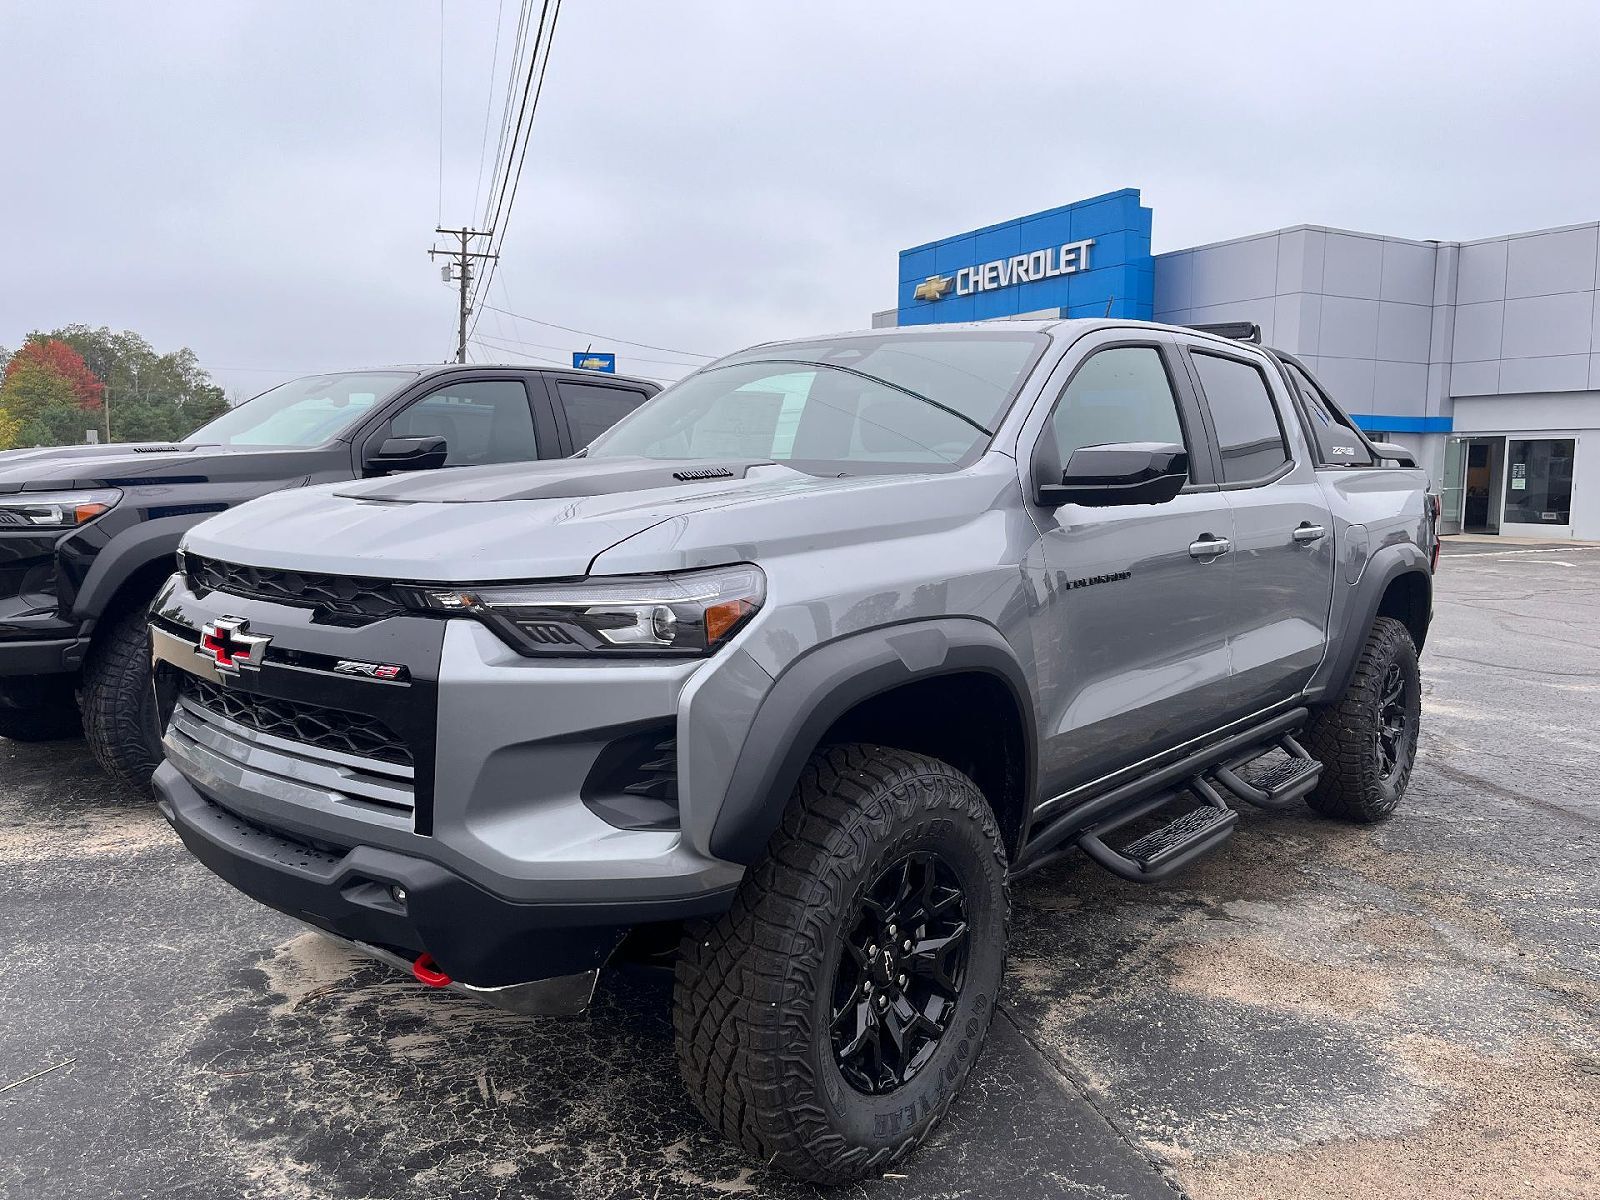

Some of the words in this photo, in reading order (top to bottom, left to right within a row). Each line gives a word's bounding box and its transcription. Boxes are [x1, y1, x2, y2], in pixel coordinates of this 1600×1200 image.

[956, 238, 1096, 296] CHEVROLET
[1065, 571, 1132, 591] COLORADO
[333, 660, 401, 678] ZR2
